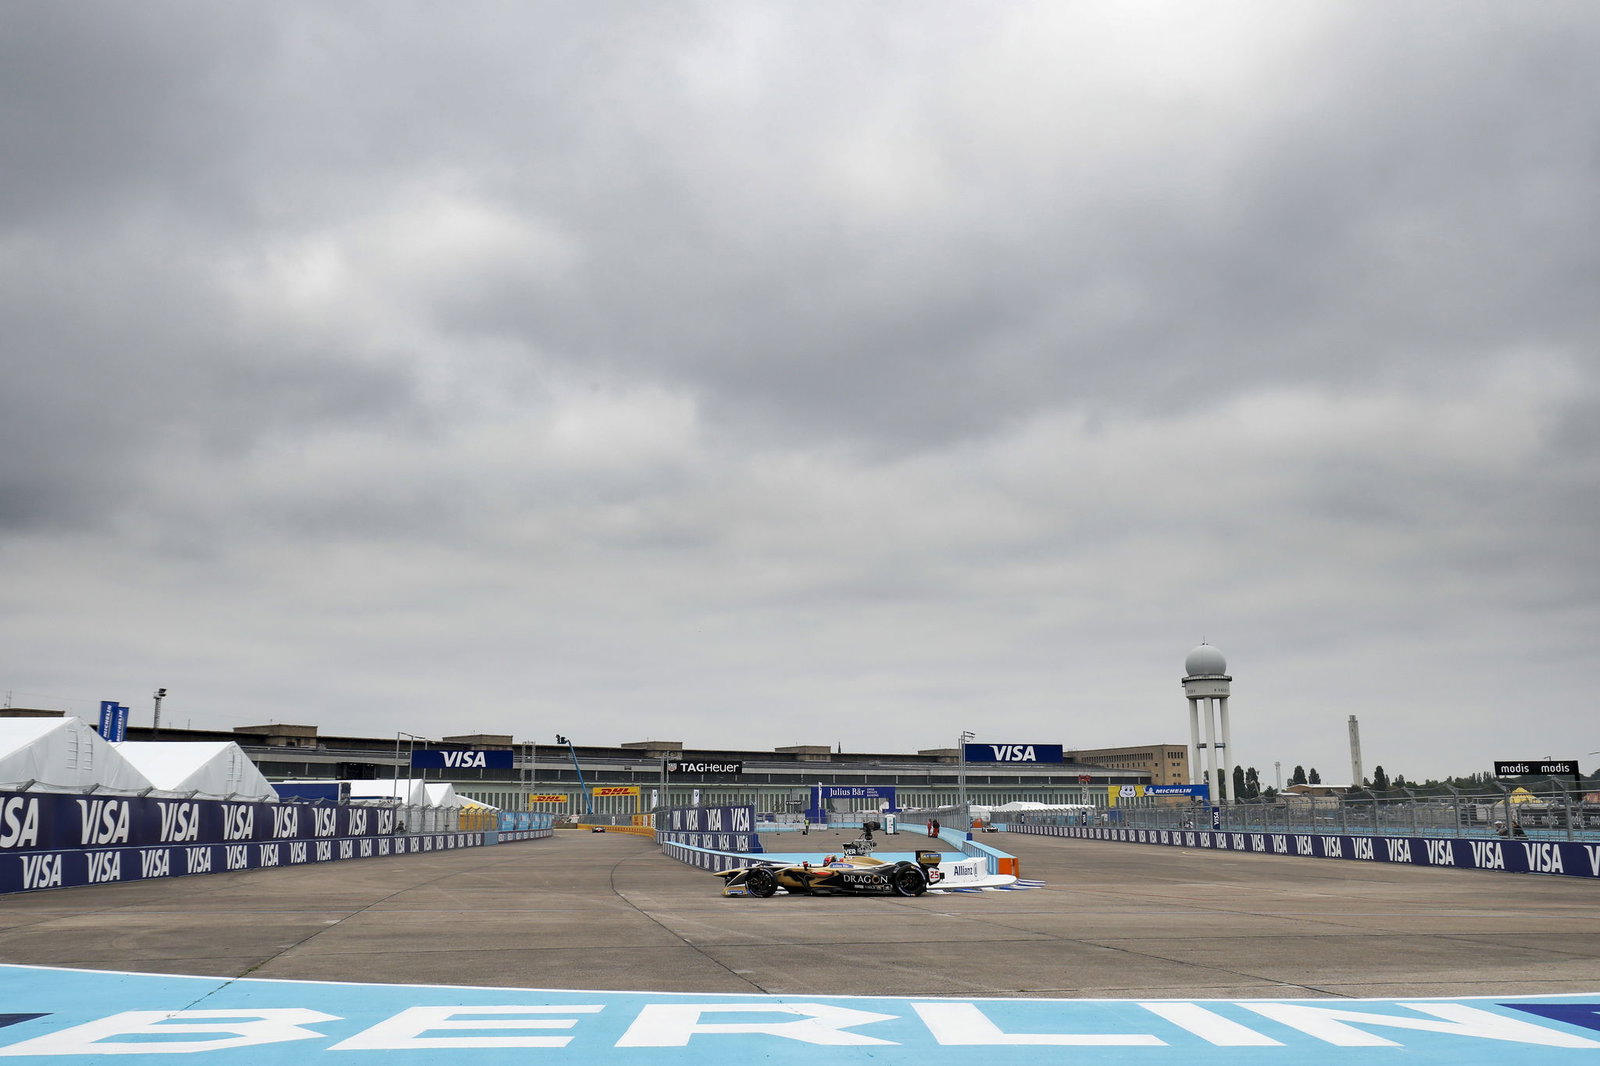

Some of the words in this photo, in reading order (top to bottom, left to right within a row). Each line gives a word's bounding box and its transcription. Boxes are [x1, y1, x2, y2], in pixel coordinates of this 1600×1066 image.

[103, 704, 112, 738] MICHELIN
[440, 751, 487, 768] VISA
[988, 744, 1037, 762] VISA
[1500, 763, 1530, 773] modis
[1540, 763, 1570, 773] modis
[600, 787, 631, 795] DHL
[829, 787, 851, 797] Julius
[851, 787, 866, 796] Bär
[76, 799, 130, 845] VISA
[157, 801, 199, 842] VISA
[221, 804, 254, 841] VISA
[271, 805, 298, 839] VISA
[312, 807, 337, 837] VISA
[348, 808, 367, 836] VISA
[377, 809, 393, 835] VISA
[685, 809, 699, 831] VISA
[706, 808, 722, 831] VISA
[731, 807, 750, 832] VISA
[718, 834, 730, 851] VISA
[736, 834, 749, 852] VISA
[1250, 833, 1266, 853] VISA
[1270, 834, 1288, 854] VISA
[1295, 835, 1313, 856] VISA
[1320, 836, 1343, 858] VISA
[1351, 837, 1374, 861] VISA
[1385, 838, 1412, 863] VISA
[1424, 839, 1455, 866] VISA
[1468, 840, 1505, 870] VISA
[1522, 842, 1564, 874] VISA
[19, 854, 62, 889] VISA
[85, 851, 121, 883] VISA
[140, 846, 170, 878] VISA
[185, 843, 211, 874] VISA
[225, 842, 248, 870] VISA
[259, 840, 279, 867] VISA
[289, 841, 307, 864] VISA
[316, 840, 332, 861] VISA
[953, 865, 973, 876] Allianz
[843, 874, 888, 884] DRAGON
[929, 870, 940, 879] 25
[0, 1003, 1600, 1056] BERLIN
